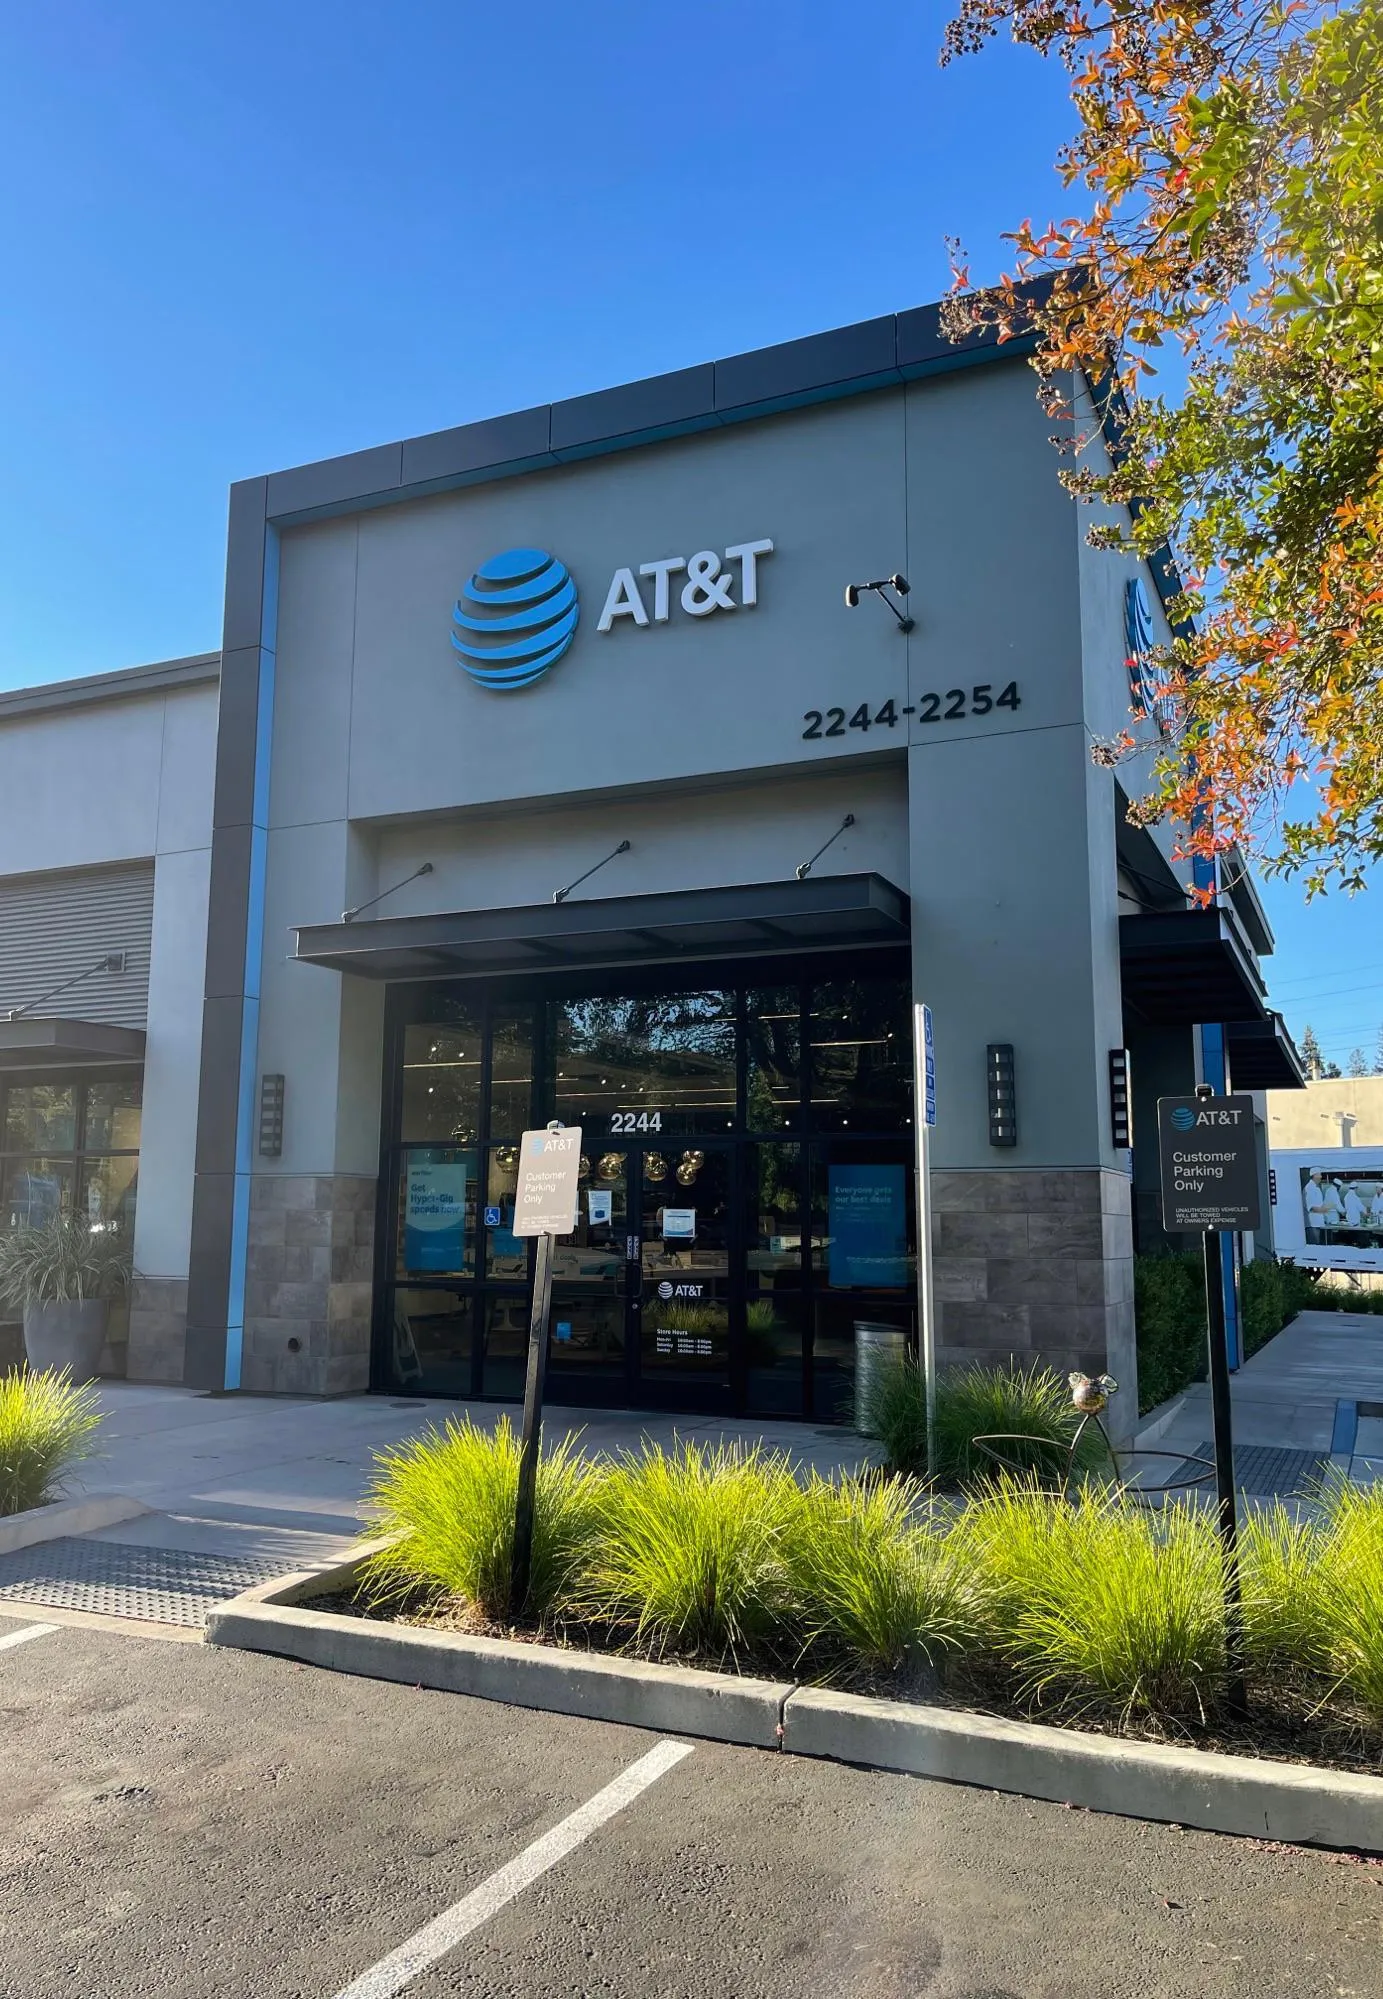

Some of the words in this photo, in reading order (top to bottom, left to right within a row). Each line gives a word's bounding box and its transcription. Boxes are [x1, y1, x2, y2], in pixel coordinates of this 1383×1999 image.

[597, 538, 774, 632] AT&T
[802, 682, 1021, 739] 2244-2254
[611, 1111, 662, 1132] 2244
[1196, 1110, 1242, 1126] AT&T
[544, 1138, 574, 1152] AT&T
[1173, 1151, 1237, 1163] Customer
[526, 1171, 567, 1182] Customer
[1174, 1165, 1223, 1178] Parking
[411, 1184, 426, 1192] Get
[525, 1182, 556, 1193] Parking
[835, 1186, 873, 1196] Everyone
[1174, 1180, 1204, 1193] Only
[523, 1194, 543, 1205] Only
[410, 1205, 440, 1216] speeds
[675, 1285, 703, 1297] AT&T
